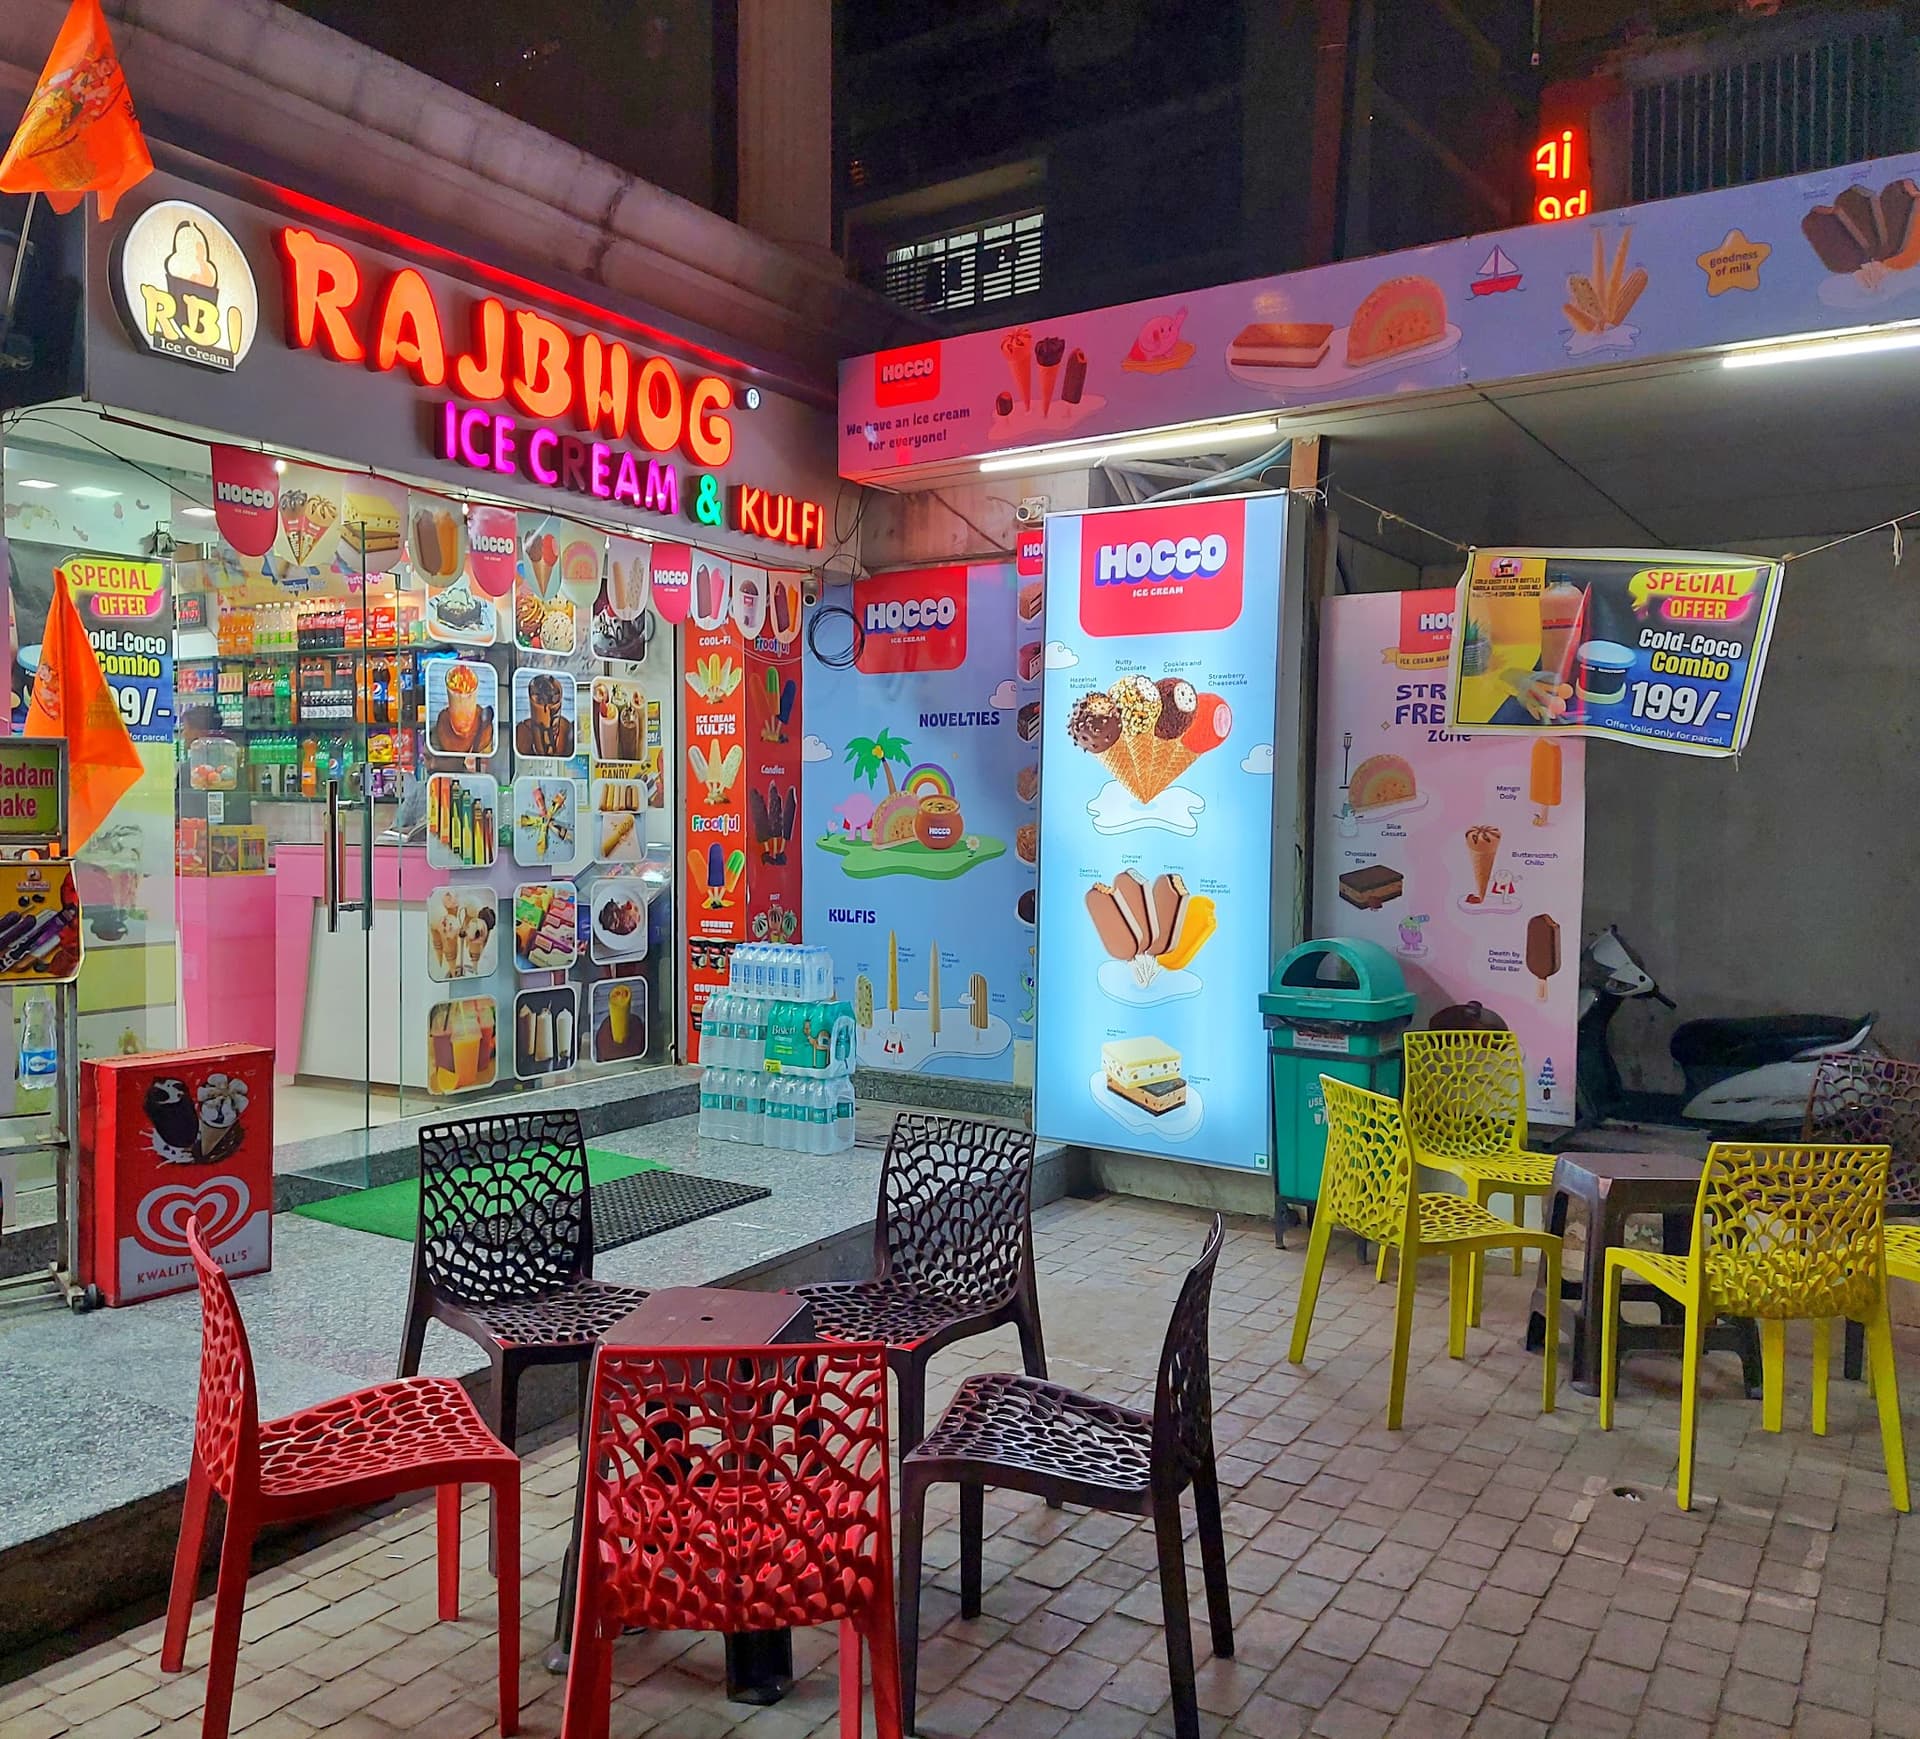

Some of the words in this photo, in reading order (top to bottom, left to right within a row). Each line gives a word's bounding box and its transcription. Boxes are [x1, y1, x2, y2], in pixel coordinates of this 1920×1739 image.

[1710, 251, 1758, 268] goodness
[1715, 267, 1727, 277] of
[1729, 263, 1752, 275] milk
[140, 283, 243, 354] RBI
[159, 337, 182, 355] Ice
[184, 344, 230, 366] Cream
[282, 225, 733, 467] RAJBHOG
[882, 358, 934, 383] HOCCO
[847, 423, 862, 435] We
[896, 416, 909, 428] an
[933, 408, 970, 422] cream
[889, 429, 947, 448] everyone!
[445, 400, 517, 475] ICE
[528, 427, 680, 515] CREAM
[695, 474, 722, 527] &
[740, 484, 825, 550] KULFI
[217, 482, 275, 510] HOCCO
[472, 535, 515, 555] HOCCO
[1096, 534, 1229, 582] HOCCO
[71, 563, 153, 591] SPECIAL
[654, 569, 689, 586] HOCCO
[1646, 571, 1739, 596] SPECIAL
[1132, 589, 1148, 597] ICE
[1150, 586, 1184, 596] CREAM
[98, 596, 148, 616] OFFER
[866, 597, 956, 632] HOCCO
[1669, 599, 1727, 620] OFFER
[86, 629, 167, 655] old-Coco
[699, 635, 731, 647] COOL-FI
[890, 637, 902, 645] ICE
[903, 635, 926, 644] CREAM
[1639, 628, 1743, 660] Cold-Coco
[1115, 664, 1147, 672] Chocolate
[1163, 660, 1189, 668] Cookies
[1651, 654, 1730, 681] Combo
[1208, 672, 1246, 680] Strawberry
[1208, 679, 1249, 687] Cheesecake
[1631, 680, 1732, 727] 199/-
[695, 715, 708, 724] ICE
[709, 714, 736, 723] CREAM
[696, 723, 736, 736] KULFIS
[919, 711, 1001, 729] NOVELTIES
[1605, 718, 1628, 729] Offer
[1631, 723, 1653, 734] Valid
[1654, 728, 1675, 739] only
[1676, 730, 1690, 740] for
[1691, 734, 1725, 745] parcel.
[0, 763, 54, 789] adam
[0, 793, 37, 818] ake
[1500, 793, 1517, 801] Dolly
[692, 813, 740, 836] Frootful
[828, 908, 876, 924] KULFIS
[137, 1259, 196, 1286] KWALITY
[211, 1249, 248, 1267] ALL'S
